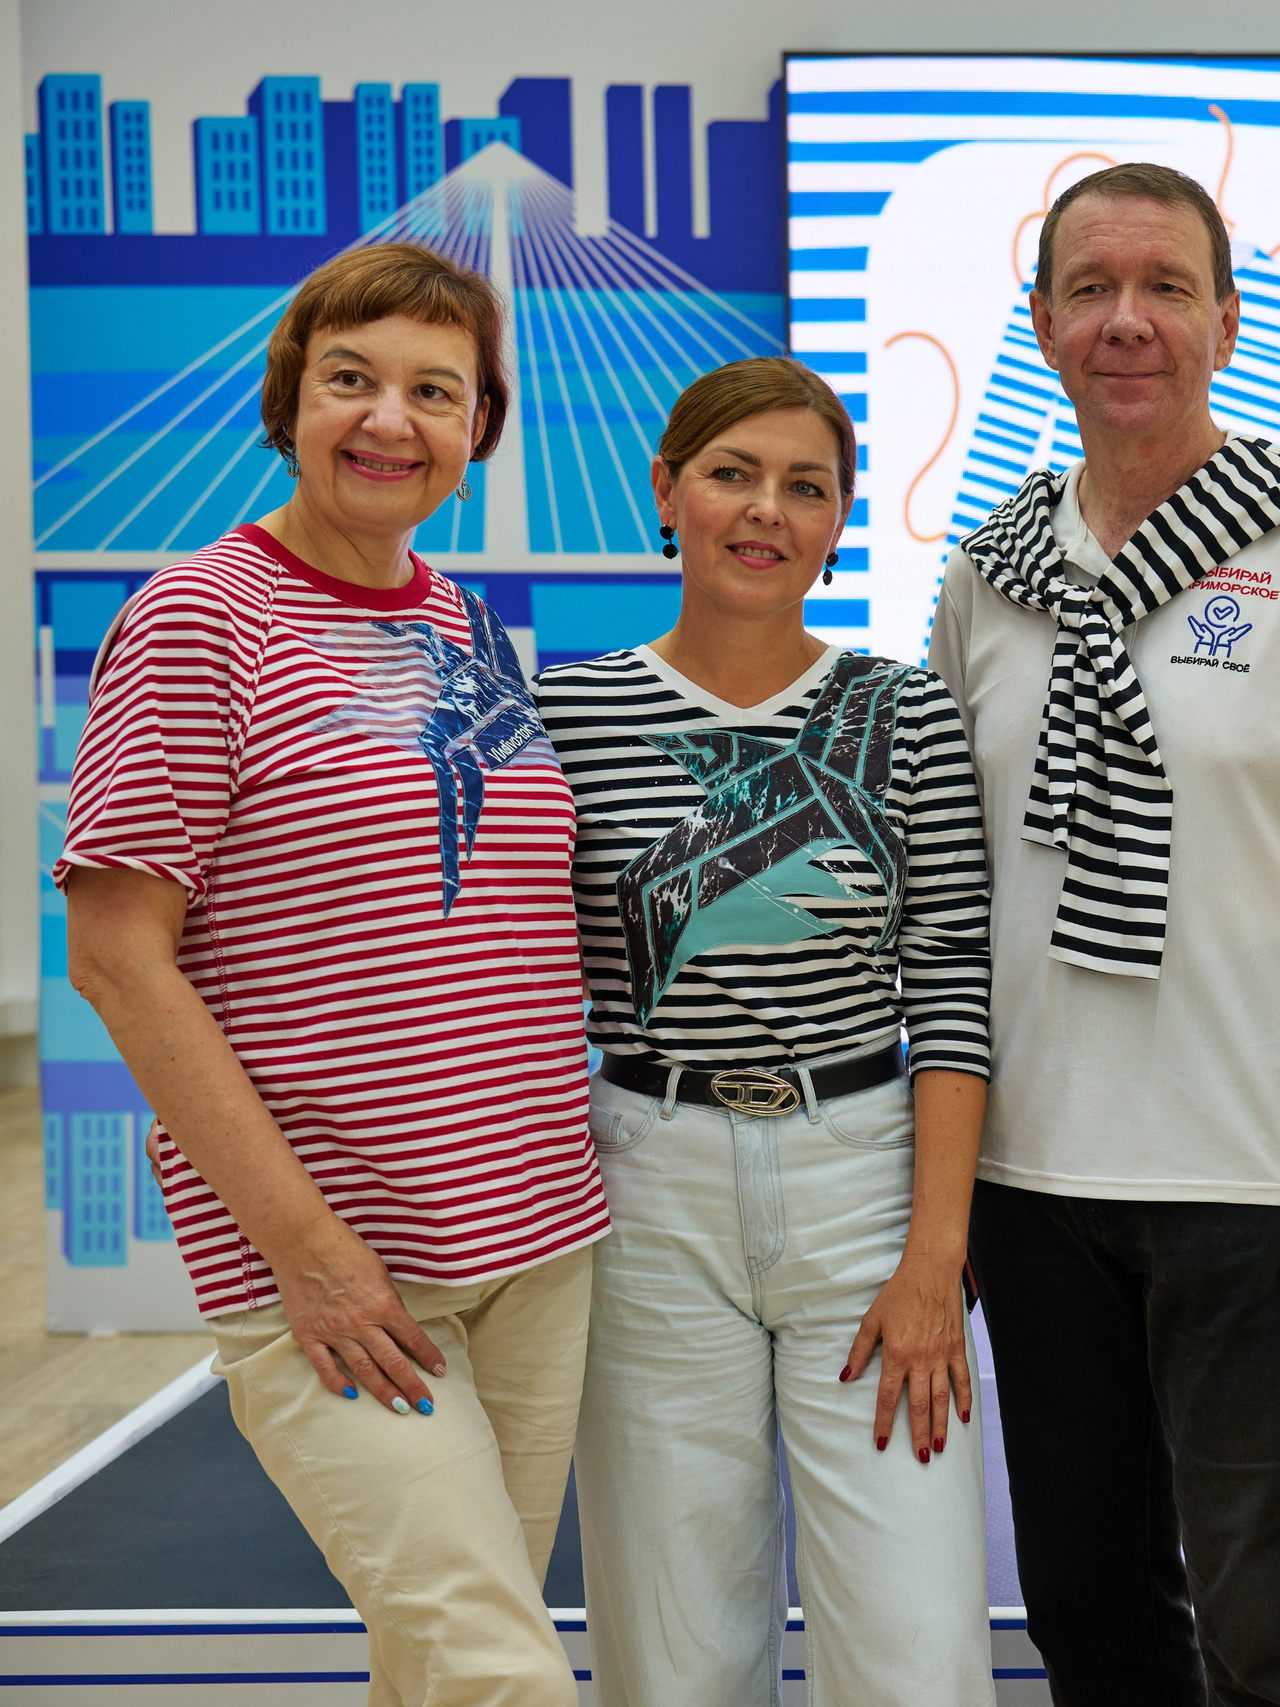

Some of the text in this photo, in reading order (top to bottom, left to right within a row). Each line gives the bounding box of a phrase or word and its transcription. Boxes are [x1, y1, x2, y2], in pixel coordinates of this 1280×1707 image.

[1205, 565, 1272, 585] ЫБИРАЙ
[1188, 580, 1280, 600] РИМОРСКОЕ
[1170, 655, 1250, 673] ВЫБИРАЙ СВОЁ
